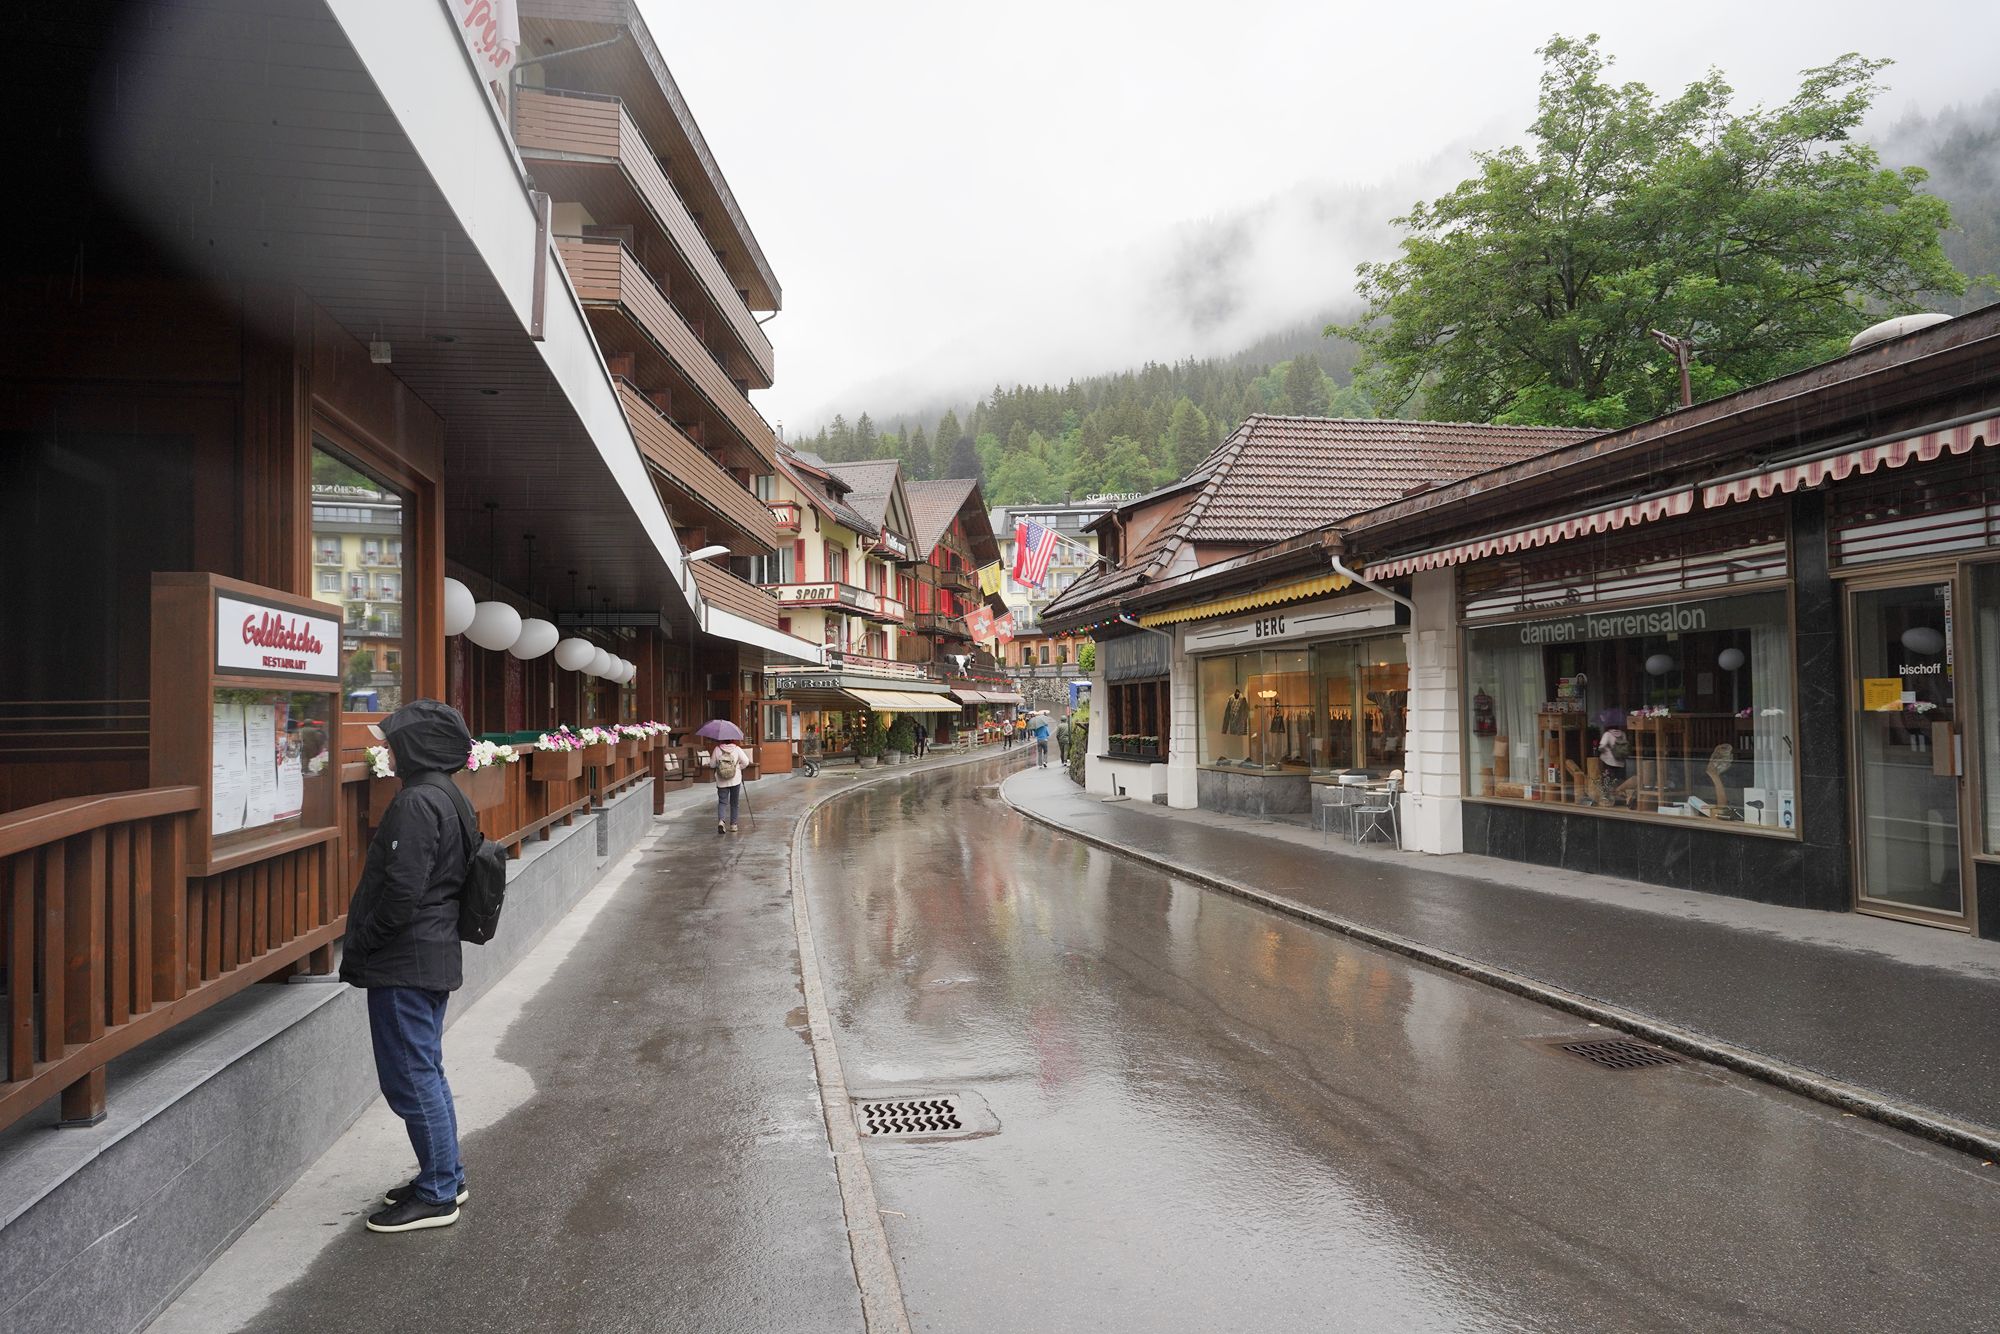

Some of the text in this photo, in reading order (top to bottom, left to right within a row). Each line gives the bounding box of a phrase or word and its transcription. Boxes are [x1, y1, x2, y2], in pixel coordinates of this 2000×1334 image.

[1086, 492, 1142, 502] SCHÖNEGG
[796, 587, 833, 599] SPORT
[1255, 614, 1285, 638] BERG
[242, 611, 323, 655] Goldlöckchen
[1141, 635, 1159, 664] BAR
[262, 656, 307, 671] RESTAURANT
[1899, 663, 1941, 675] bischoff
[801, 678, 840, 689] Rent
